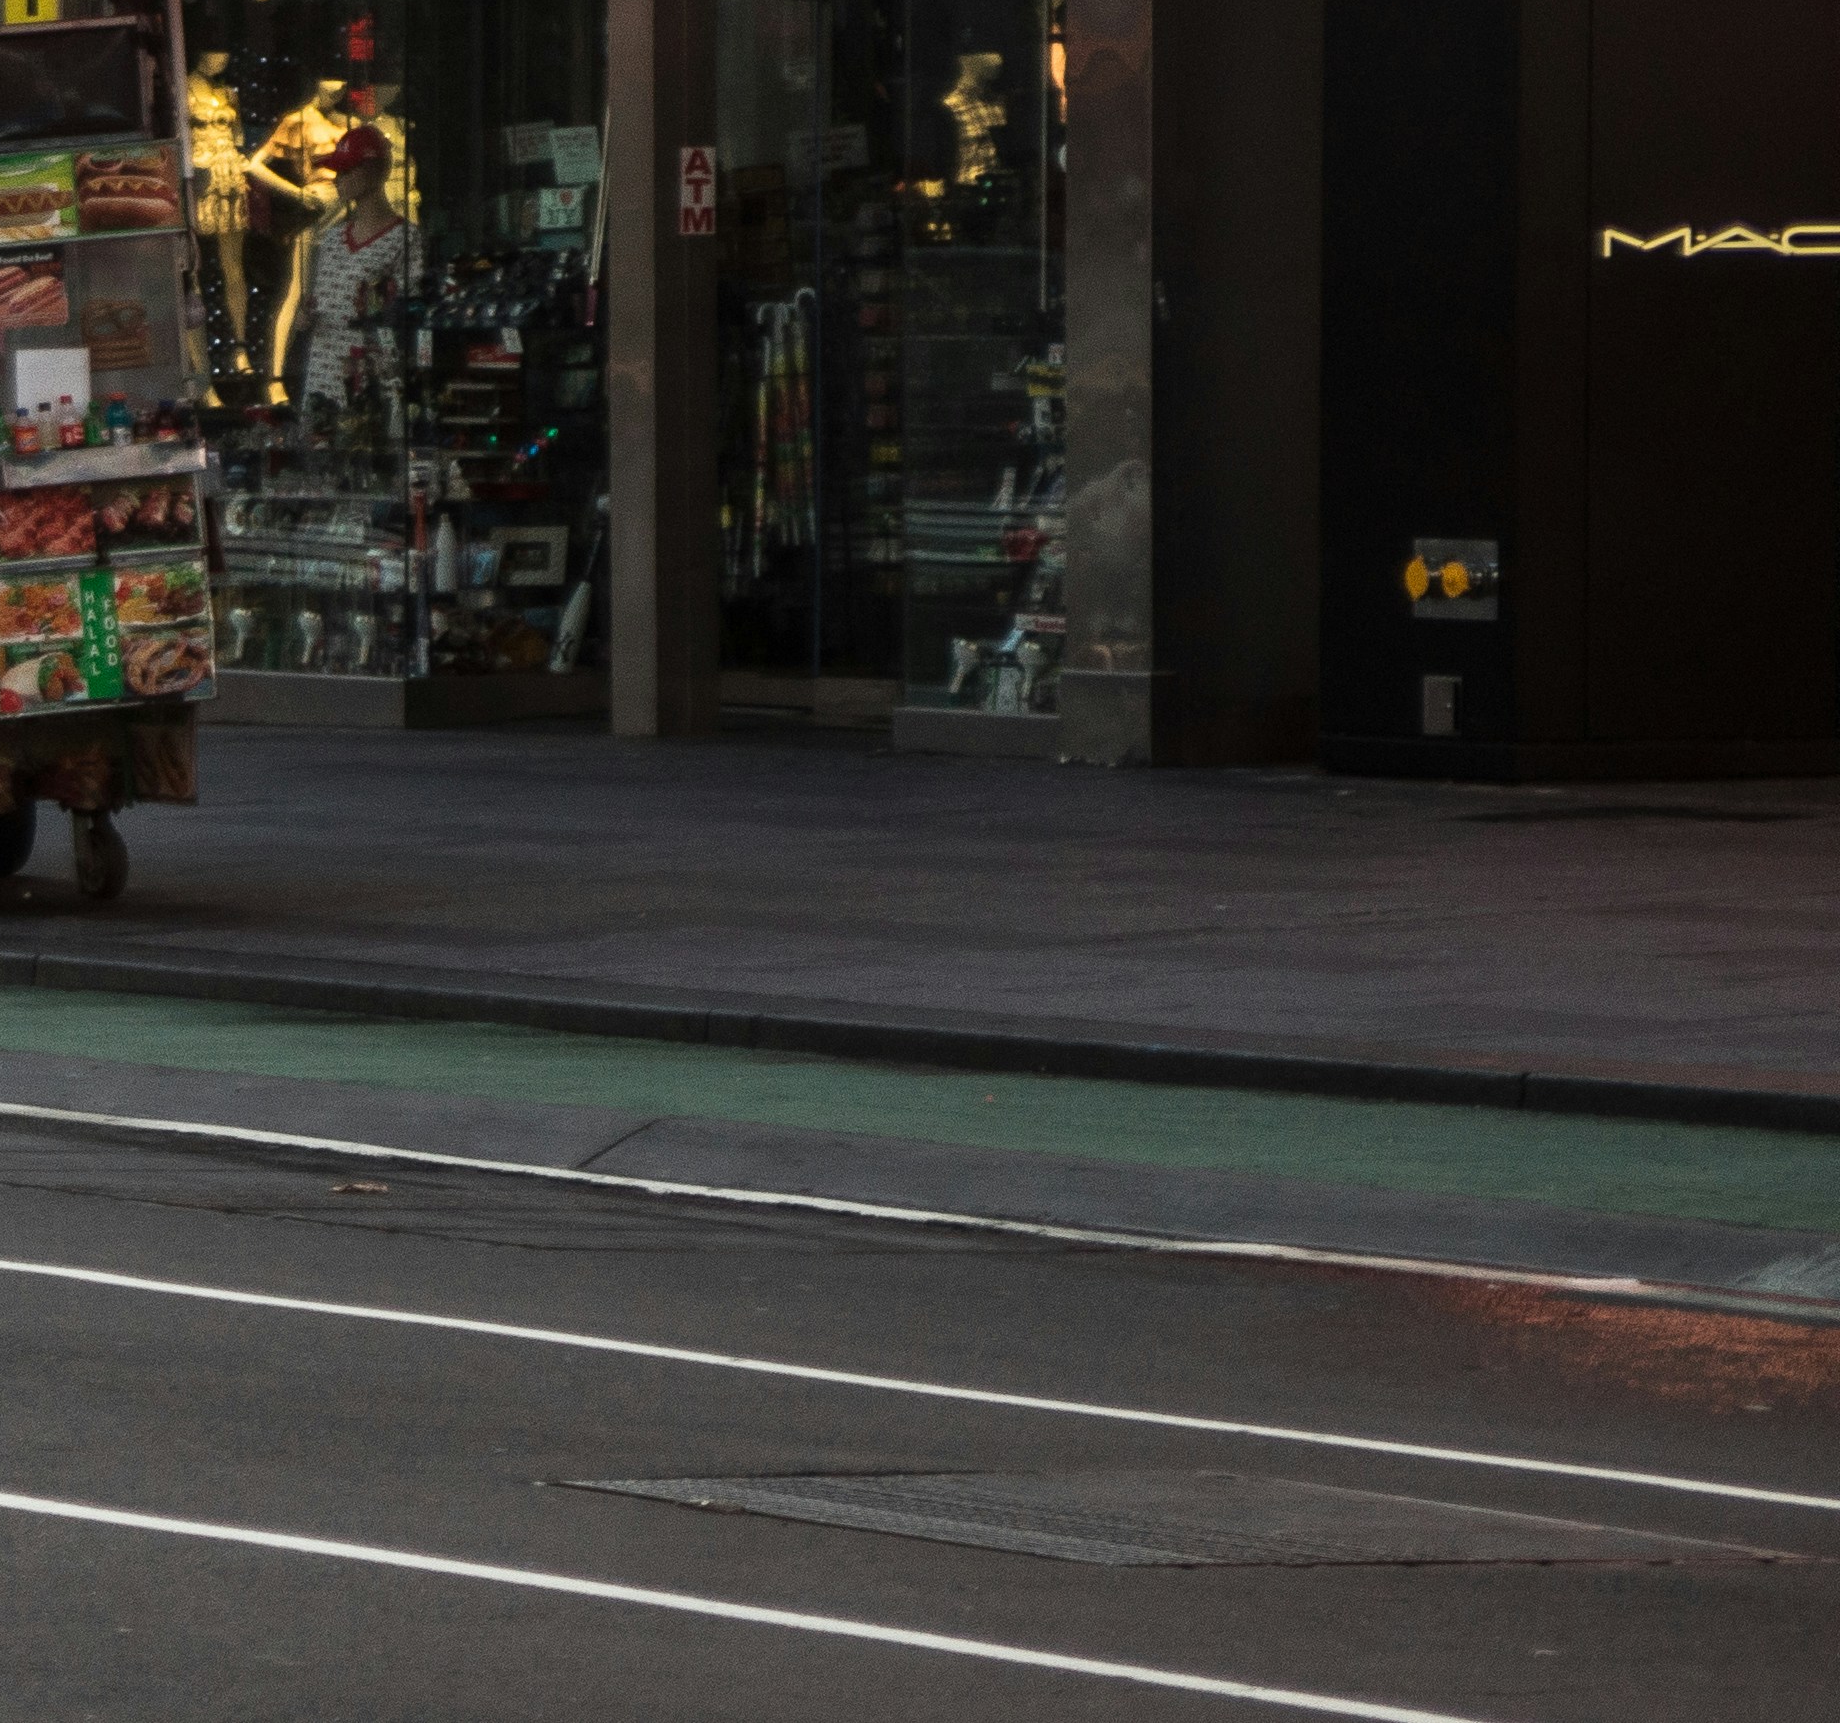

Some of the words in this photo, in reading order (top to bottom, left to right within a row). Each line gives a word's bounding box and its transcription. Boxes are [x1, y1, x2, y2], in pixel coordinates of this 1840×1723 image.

[684, 149, 712, 233] ATM
[84, 589, 101, 676] HALAL
[103, 598, 118, 666] FOOD
